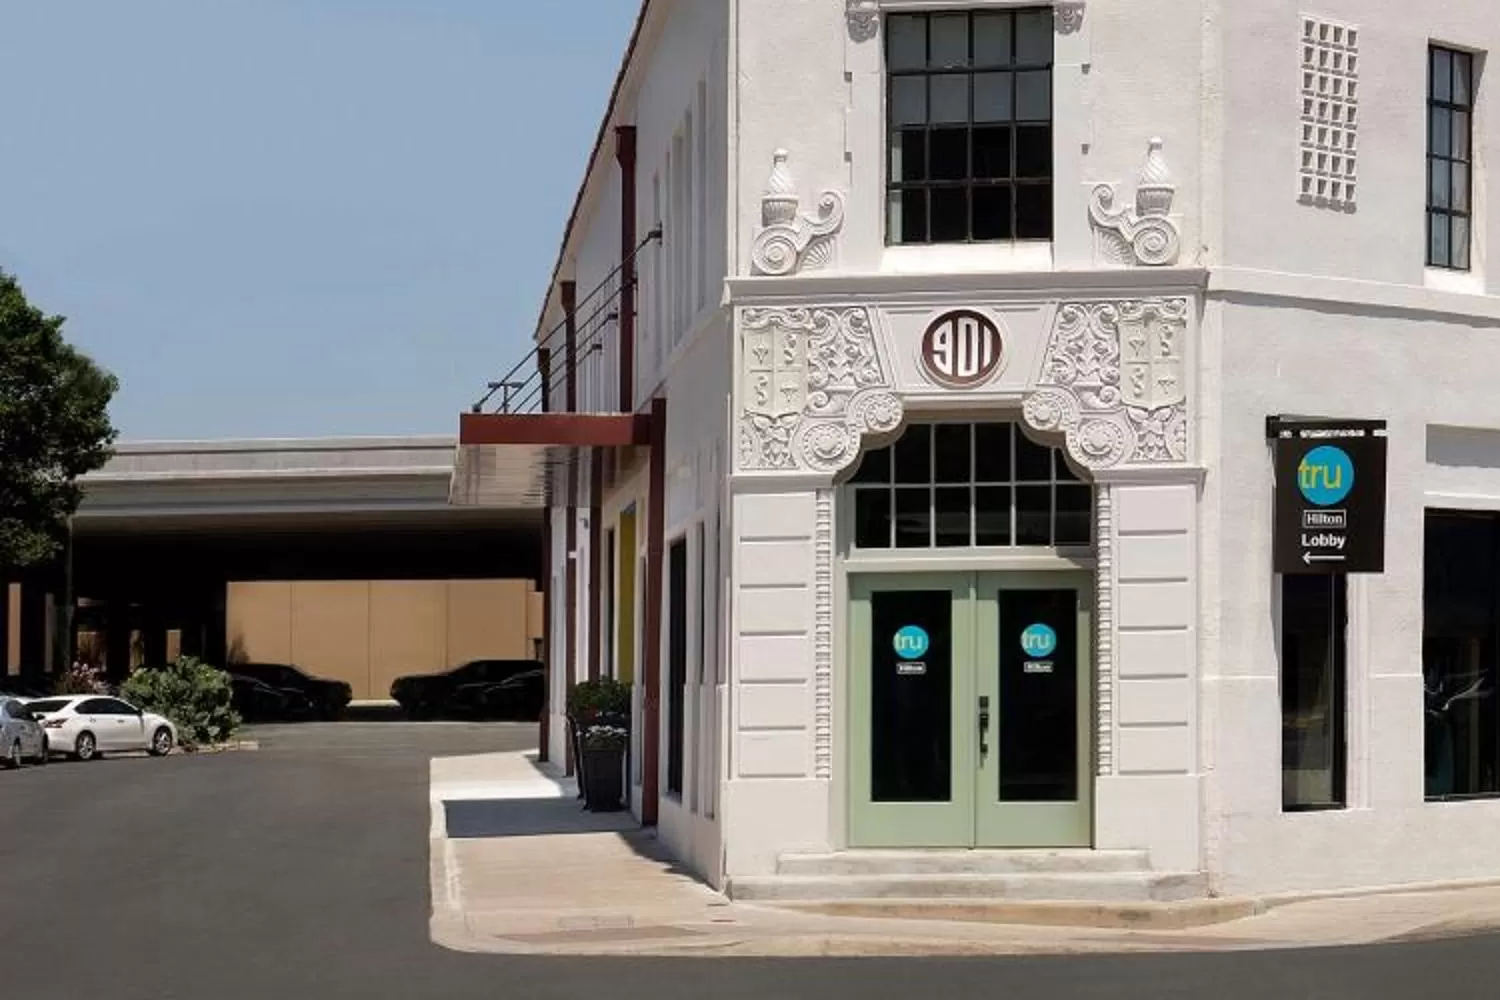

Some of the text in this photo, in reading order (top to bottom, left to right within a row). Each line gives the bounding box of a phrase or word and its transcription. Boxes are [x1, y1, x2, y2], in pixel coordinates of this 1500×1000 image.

[1298, 459, 1341, 488] tru
[1307, 512, 1343, 525] Hilton
[1302, 533, 1346, 549] Lobby
[894, 632, 923, 649] tru
[1022, 631, 1050, 648] tru
